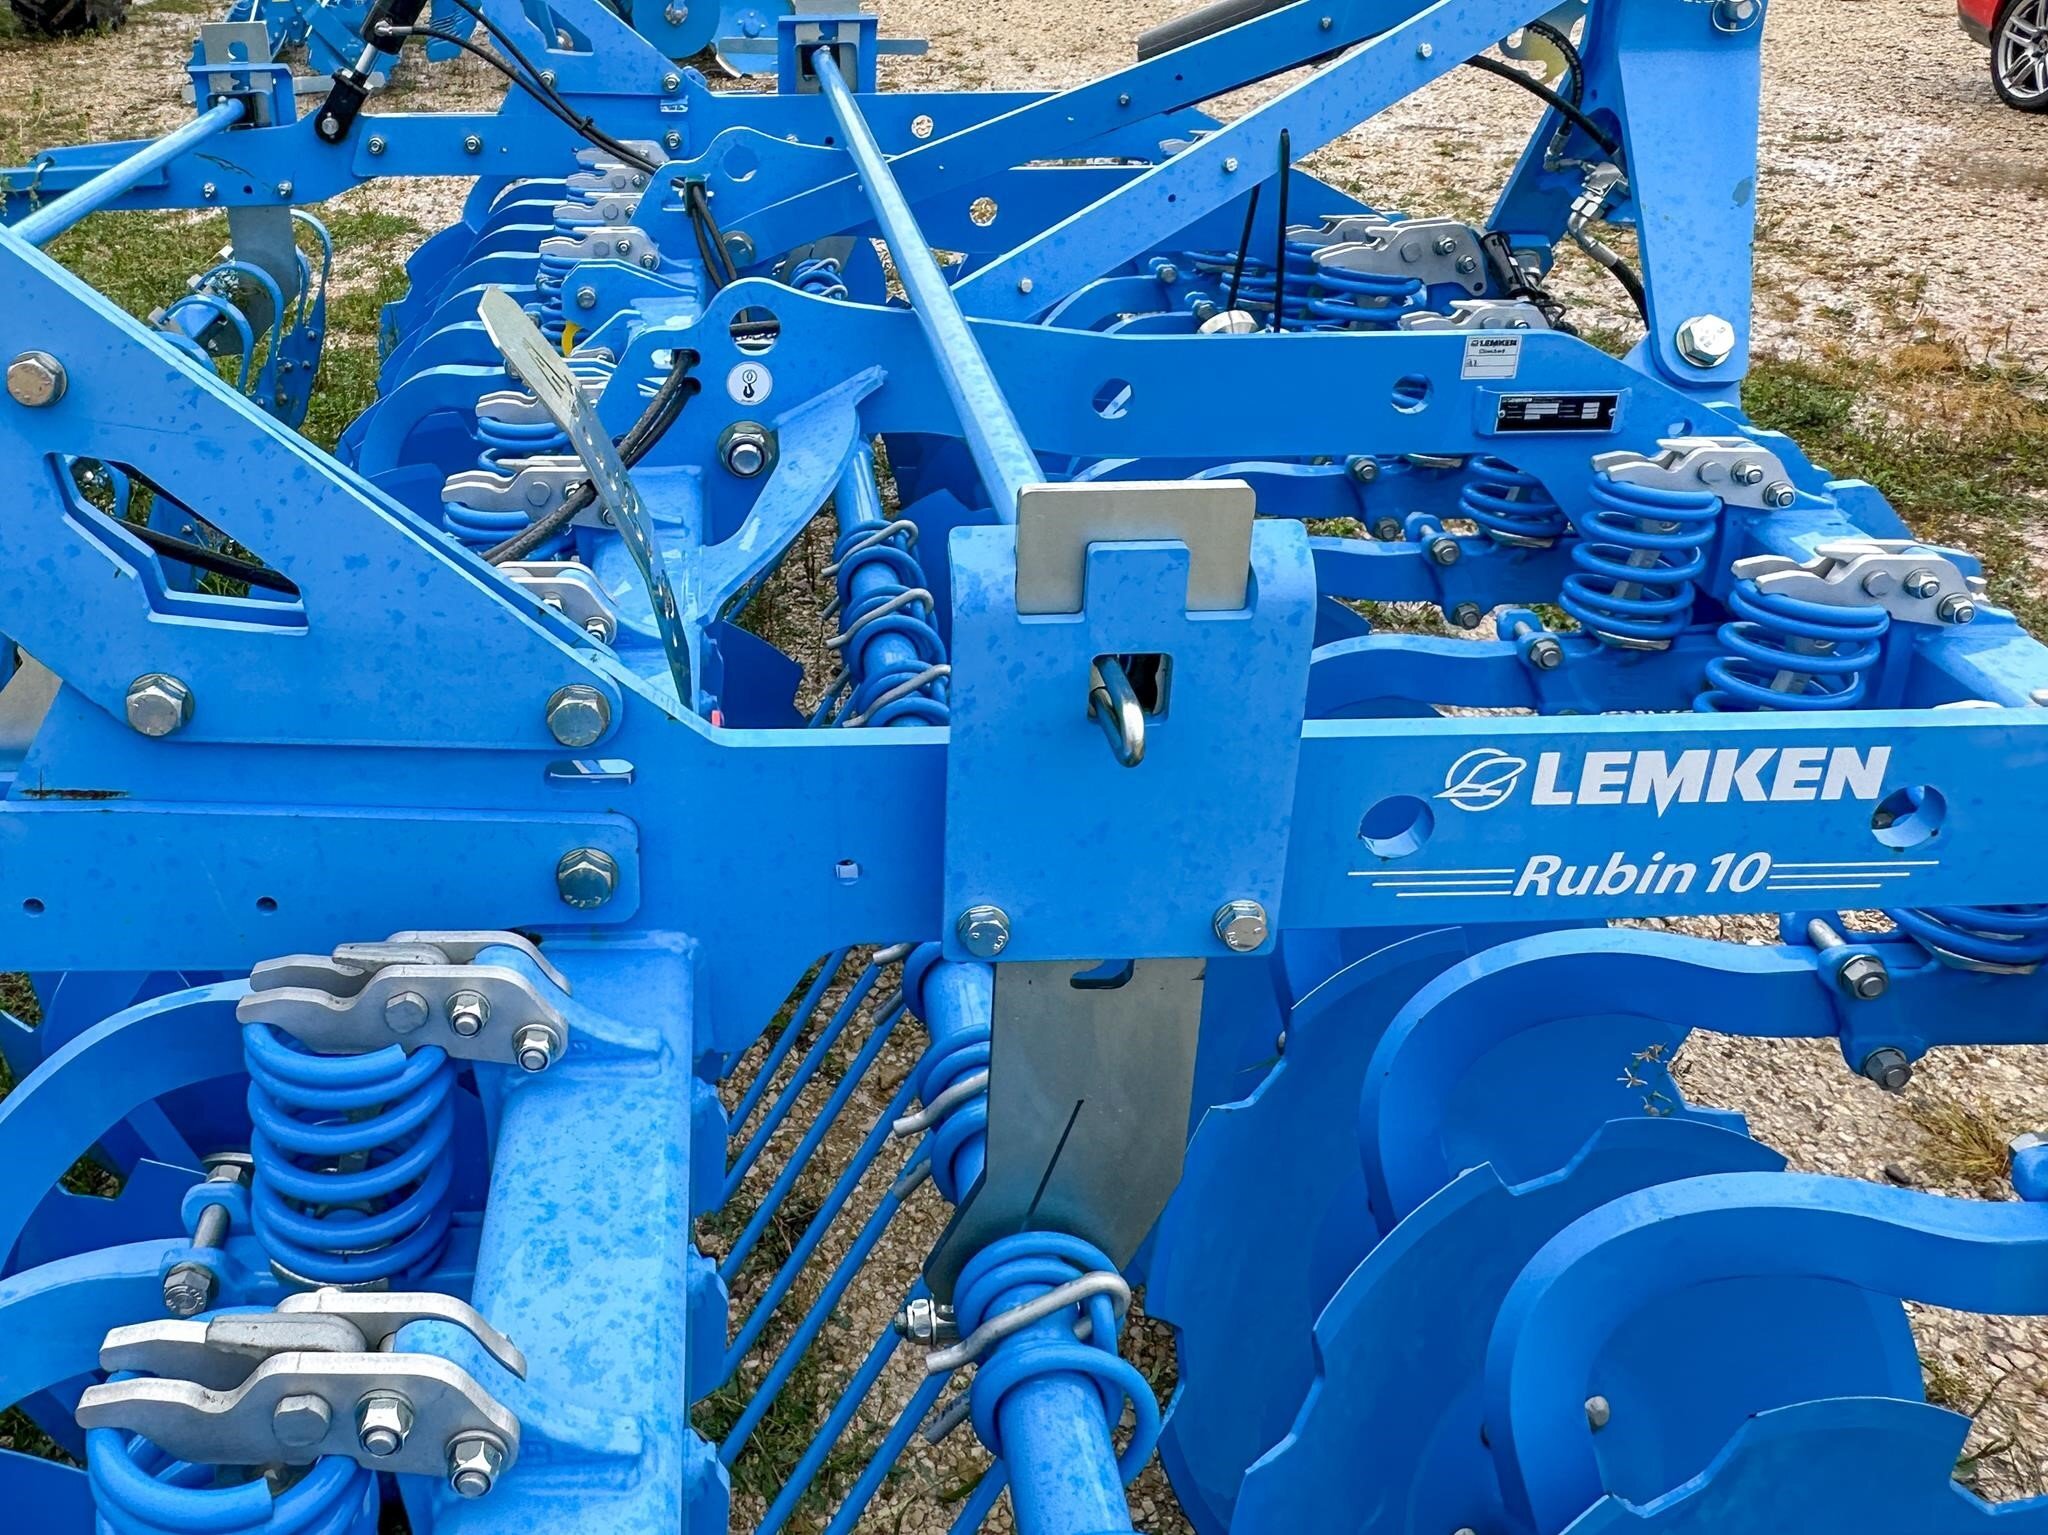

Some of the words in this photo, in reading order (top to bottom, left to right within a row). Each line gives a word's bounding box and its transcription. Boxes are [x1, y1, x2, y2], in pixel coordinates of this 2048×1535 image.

[1531, 746, 1892, 818] LEMKEN
[1513, 850, 1697, 897] Rubin
[1707, 851, 1772, 893] 10
